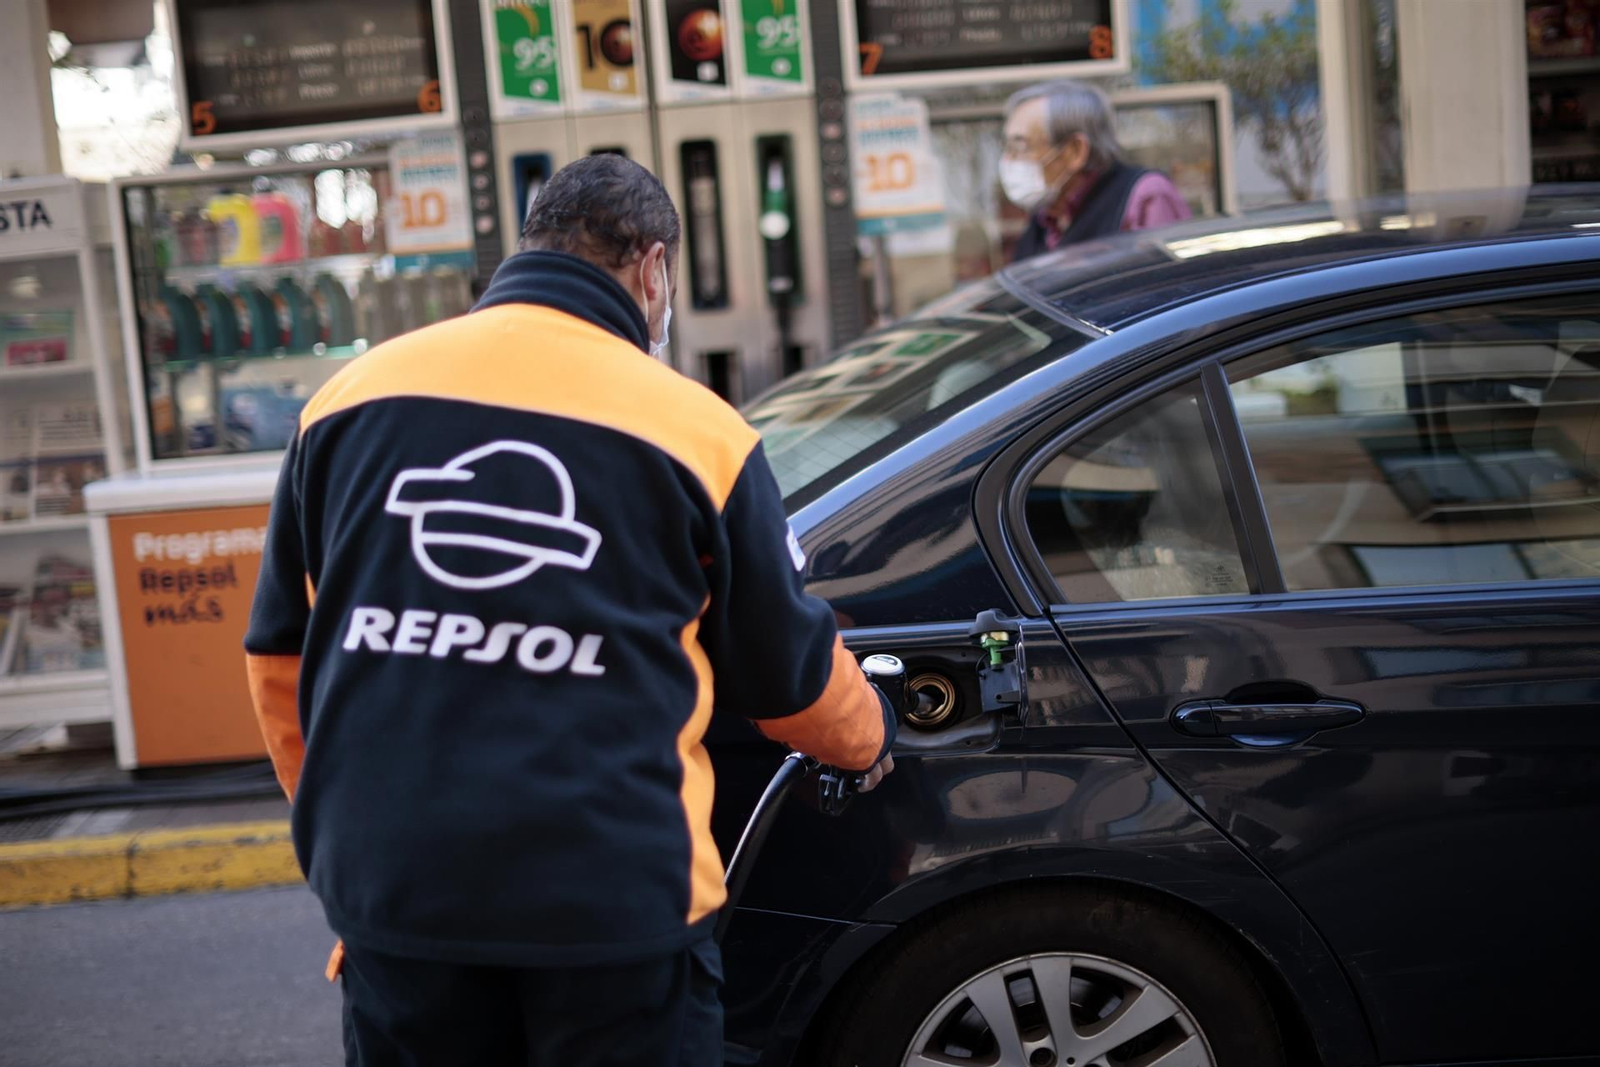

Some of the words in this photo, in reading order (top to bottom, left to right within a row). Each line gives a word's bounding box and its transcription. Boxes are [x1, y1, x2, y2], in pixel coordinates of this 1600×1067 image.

[756, 15, 799, 48] 95
[1089, 25, 1113, 60] 8
[513, 36, 556, 70] 95
[859, 42, 884, 76] 7
[418, 80, 442, 113] 6
[192, 102, 216, 135] 5
[866, 152, 915, 193] 10
[400, 190, 447, 229] 10
[139, 560, 238, 594] Repsol
[343, 607, 606, 675] REPSOL
